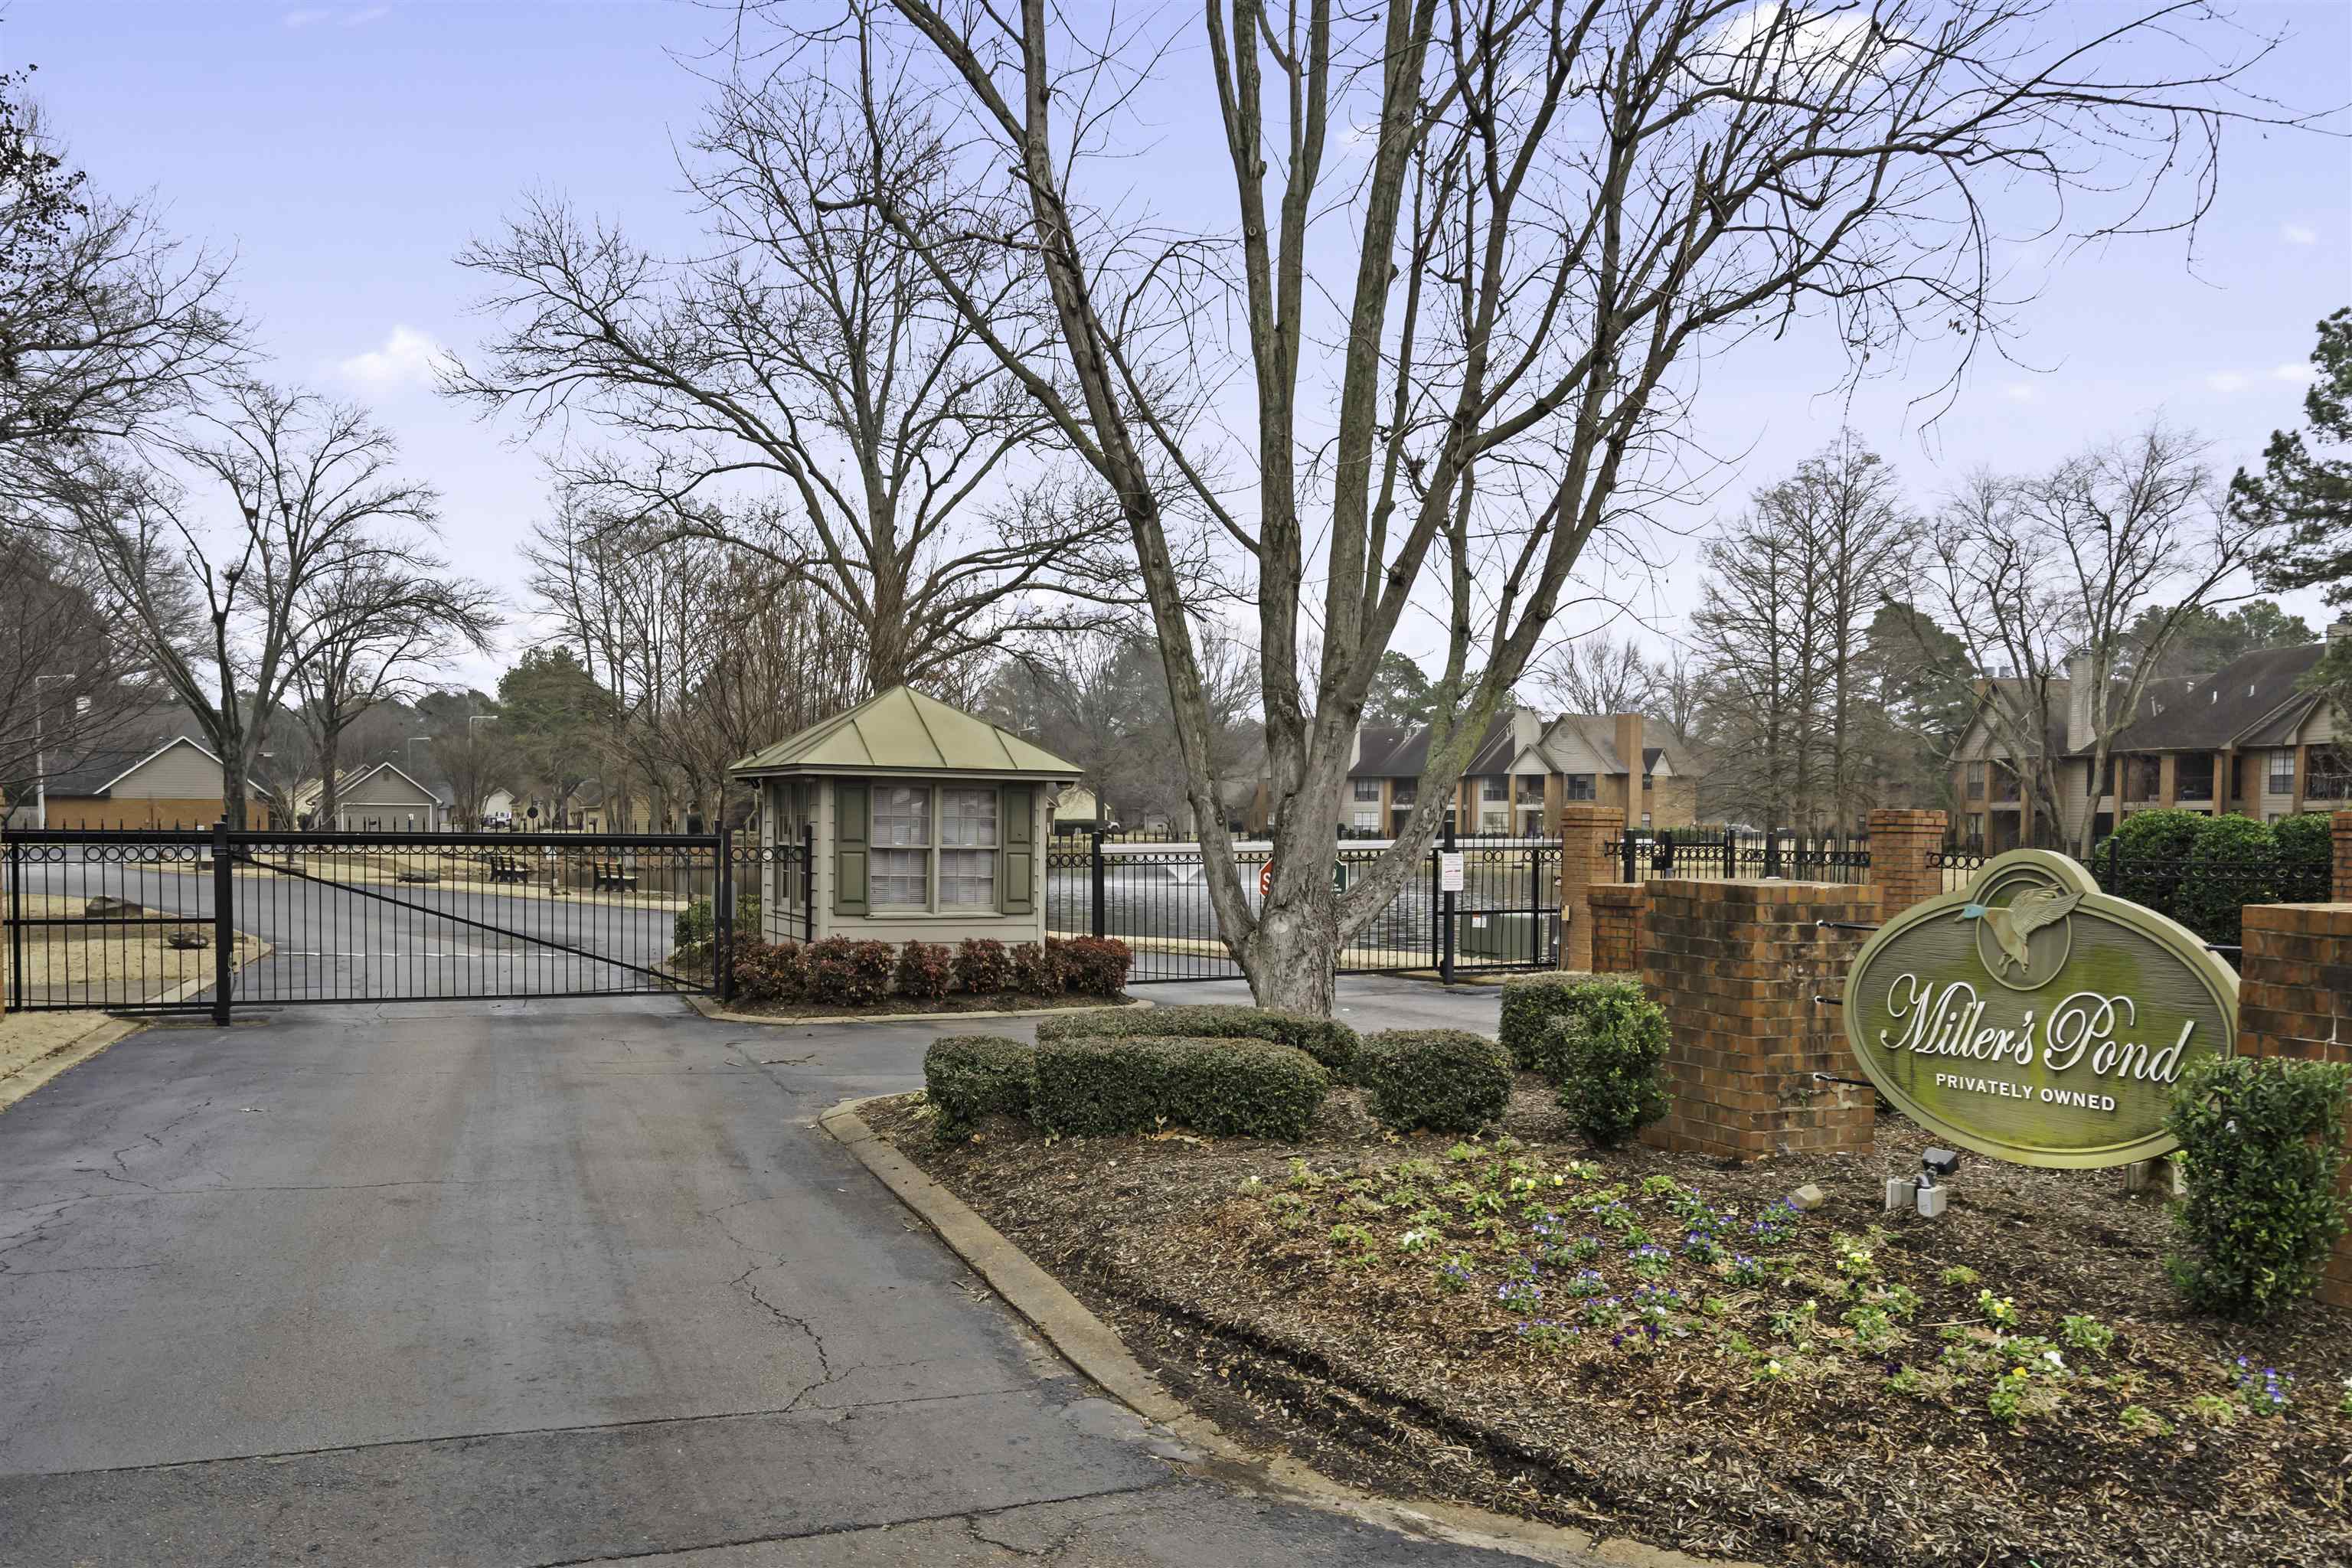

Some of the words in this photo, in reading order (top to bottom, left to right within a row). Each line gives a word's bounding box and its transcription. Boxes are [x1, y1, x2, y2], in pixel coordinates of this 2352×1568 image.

[1880, 974, 2035, 1064] Miller's
[2043, 992, 2195, 1083] Pond
[1936, 1073, 2034, 1099] PRIVATELY
[2040, 1089, 2115, 1111] OWNED
